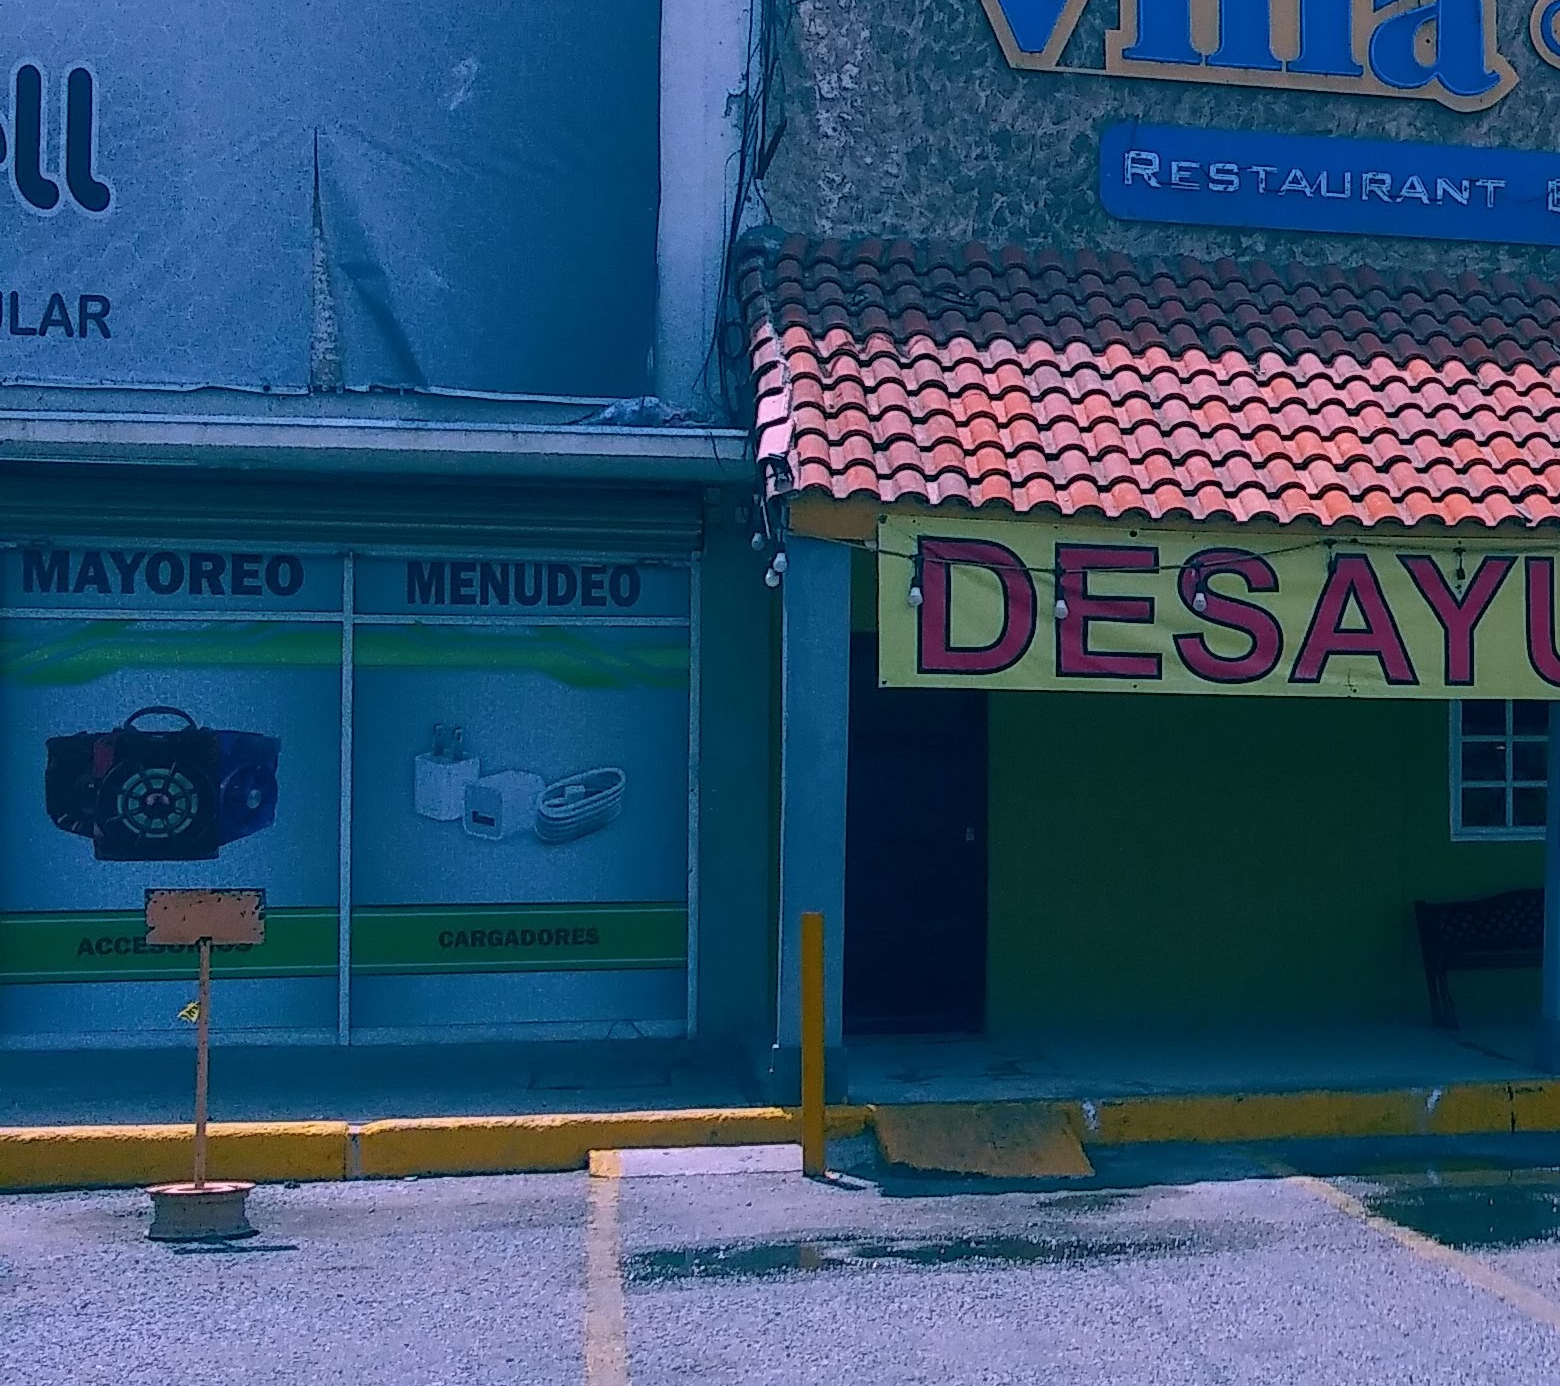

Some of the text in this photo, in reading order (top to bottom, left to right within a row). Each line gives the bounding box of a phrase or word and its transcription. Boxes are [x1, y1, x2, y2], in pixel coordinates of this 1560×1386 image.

[0, 63, 112, 213] ll
[0, 290, 112, 339] LAR
[21, 549, 305, 597] MAYOREO
[405, 560, 643, 608] MENUDEO
[76, 935, 253, 956] ACCESOOS
[437, 927, 601, 949] CARGADORES
